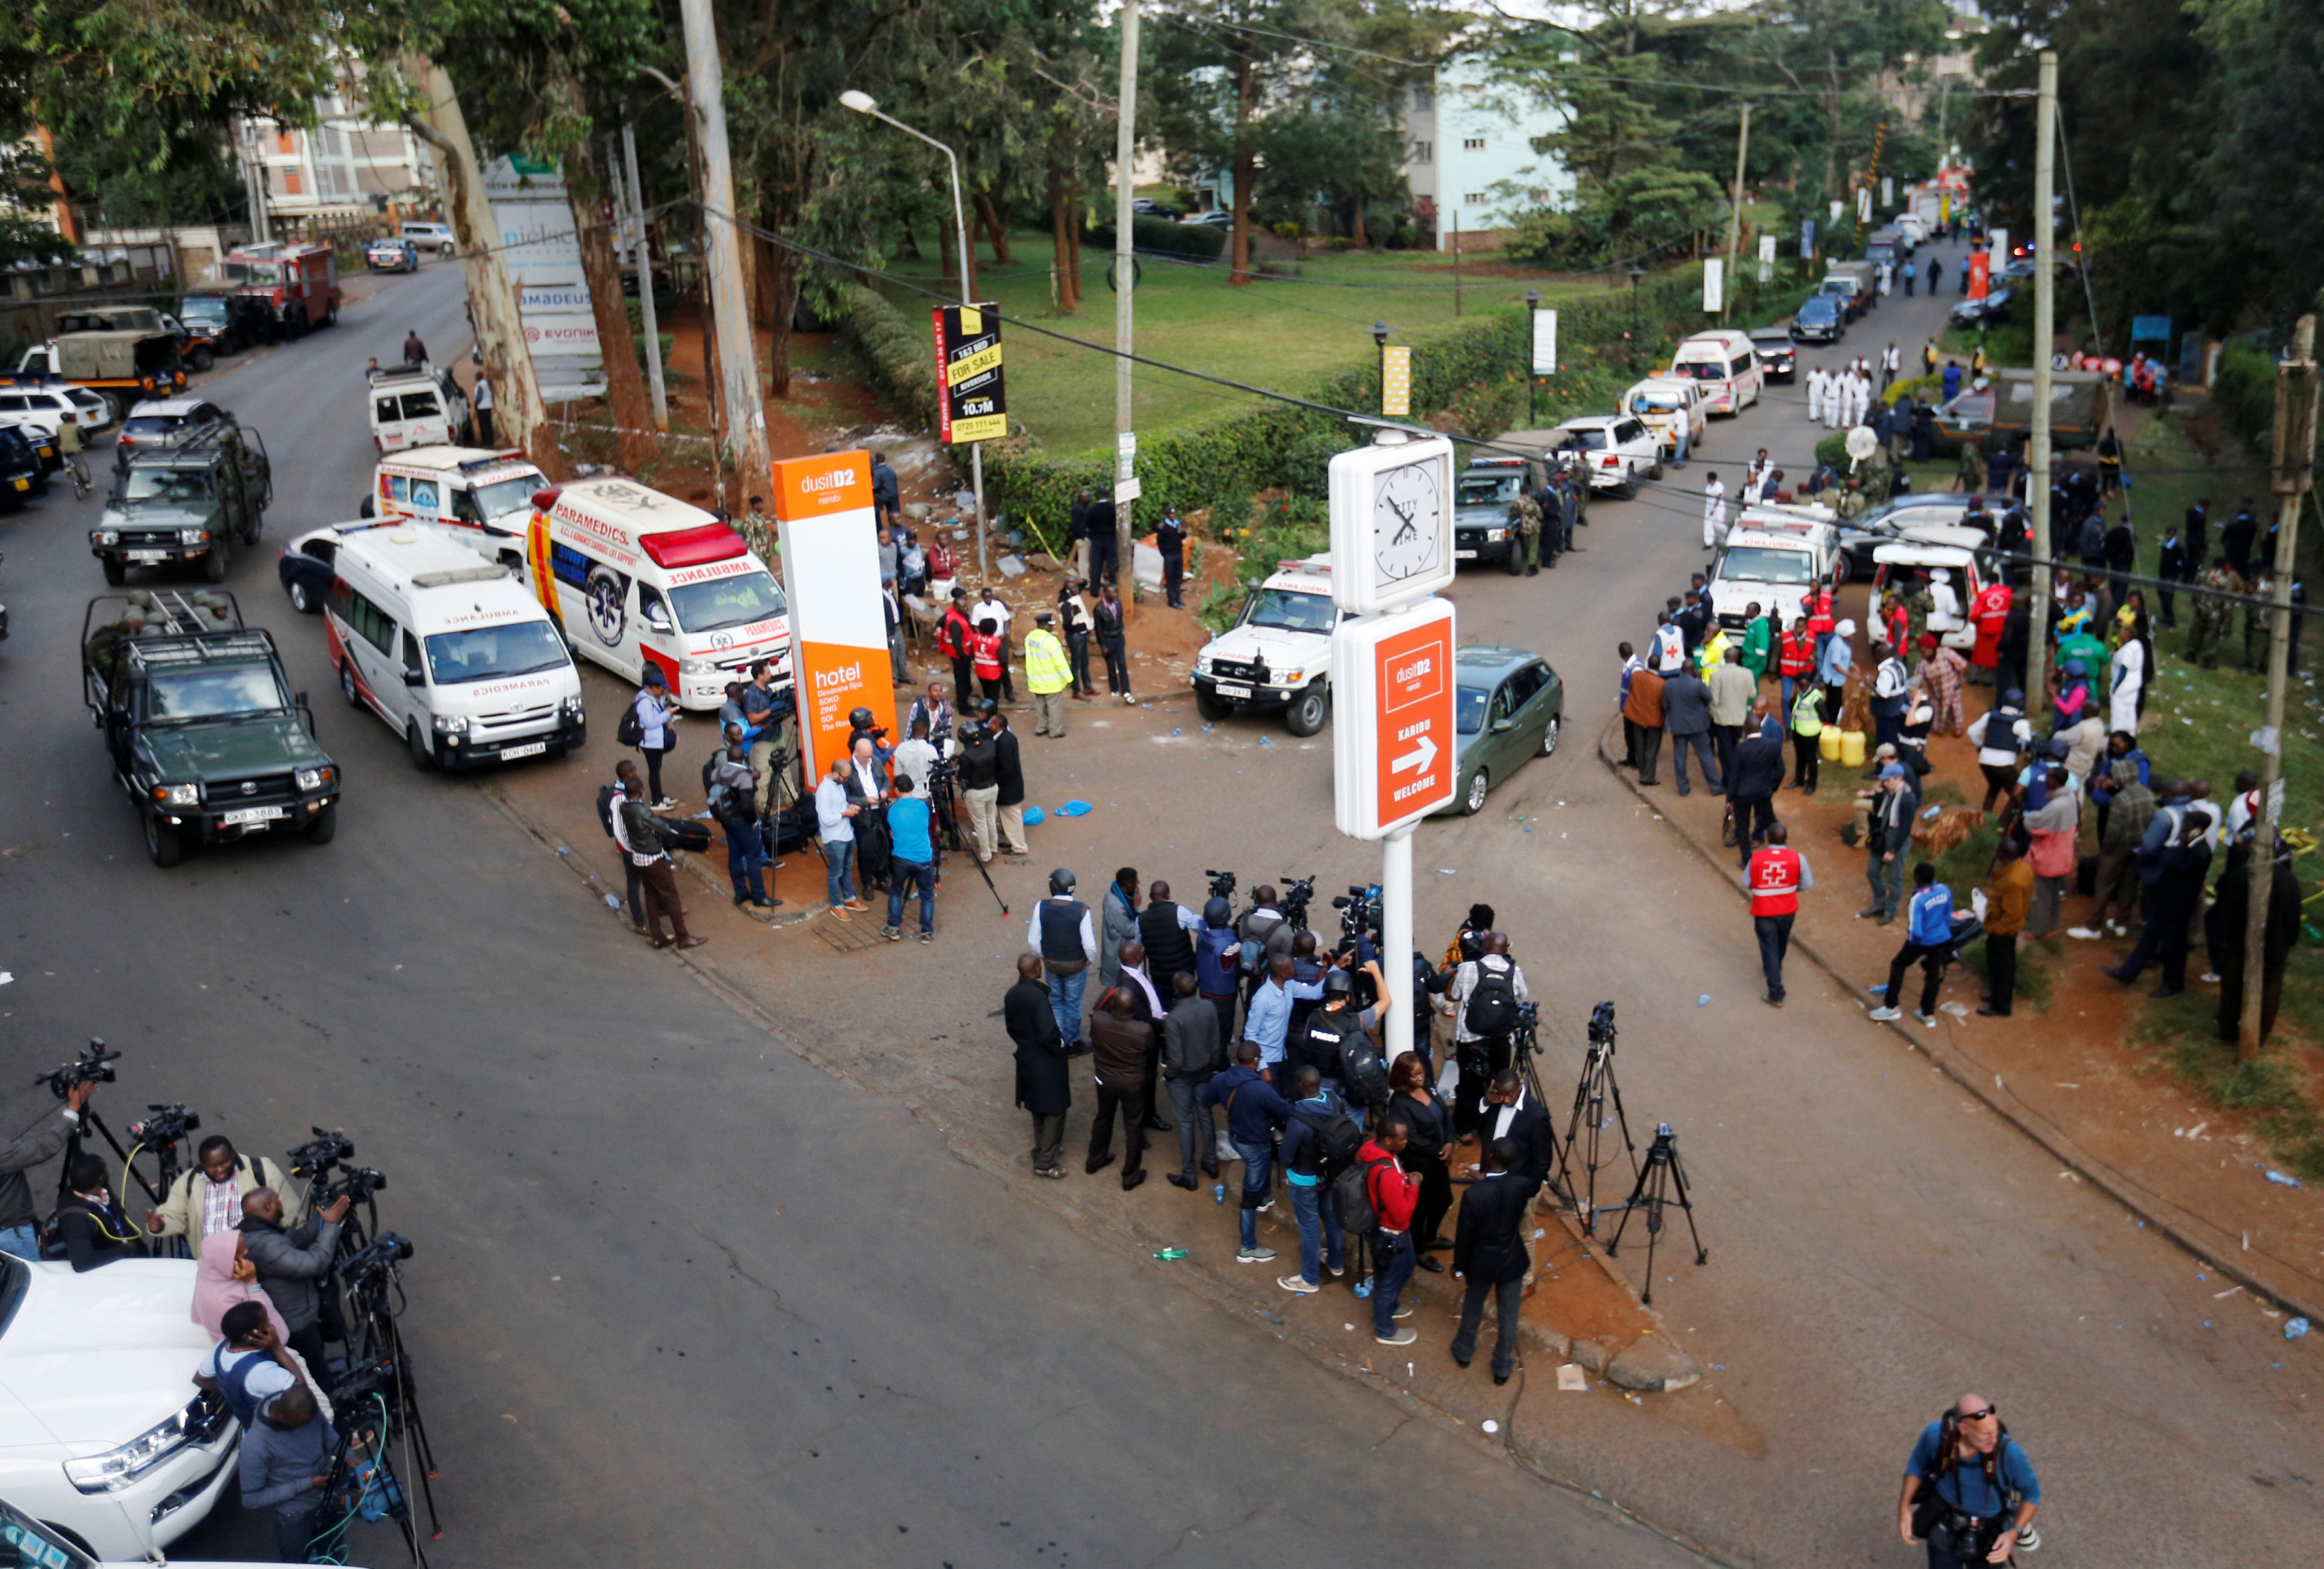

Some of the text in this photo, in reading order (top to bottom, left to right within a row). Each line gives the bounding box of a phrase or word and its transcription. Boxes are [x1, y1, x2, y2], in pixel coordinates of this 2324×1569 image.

[952, 351, 996, 380] FOR SALE
[962, 400, 993, 416] 10.7M
[801, 468, 855, 493] dusitD2
[818, 493, 841, 505] nairobi
[556, 503, 627, 544] PARAMEDICS
[744, 618, 786, 638] PARAMEDICS
[815, 661, 861, 689] hotel
[1396, 658, 1431, 683] dusitD2
[817, 681, 863, 697] Devarana Spa
[819, 695, 839, 706] SOKO
[820, 704, 837, 715] ZING
[821, 714, 833, 723] SOI
[822, 723, 835, 732] The
[1398, 718, 1431, 742] KARIBU
[1394, 774, 1436, 802] WELCOME
[1311, 1029, 1340, 1043] PRESS
